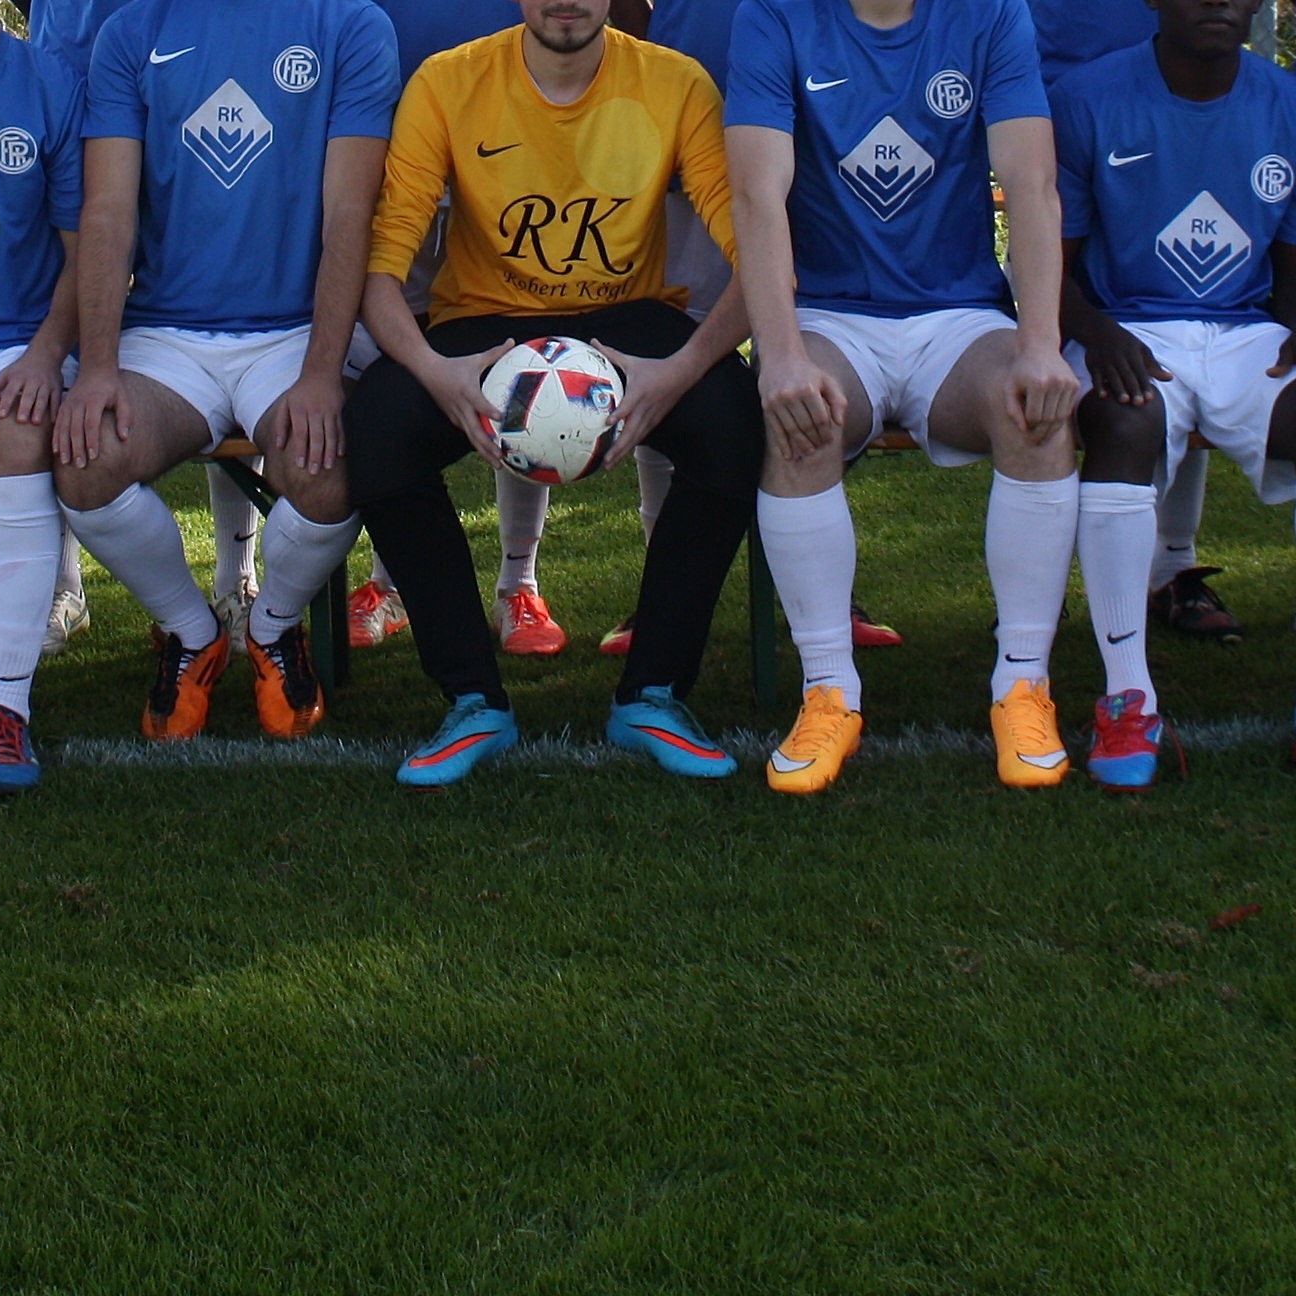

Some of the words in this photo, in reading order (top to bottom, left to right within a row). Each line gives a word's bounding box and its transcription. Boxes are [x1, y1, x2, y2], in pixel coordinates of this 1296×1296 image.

[217, 106, 243, 123] RK
[874, 144, 902, 160] RK
[498, 193, 634, 276] RK
[1190, 218, 1217, 235] RK
[503, 272, 568, 297] Robert
[576, 275, 634, 302] Kögl
